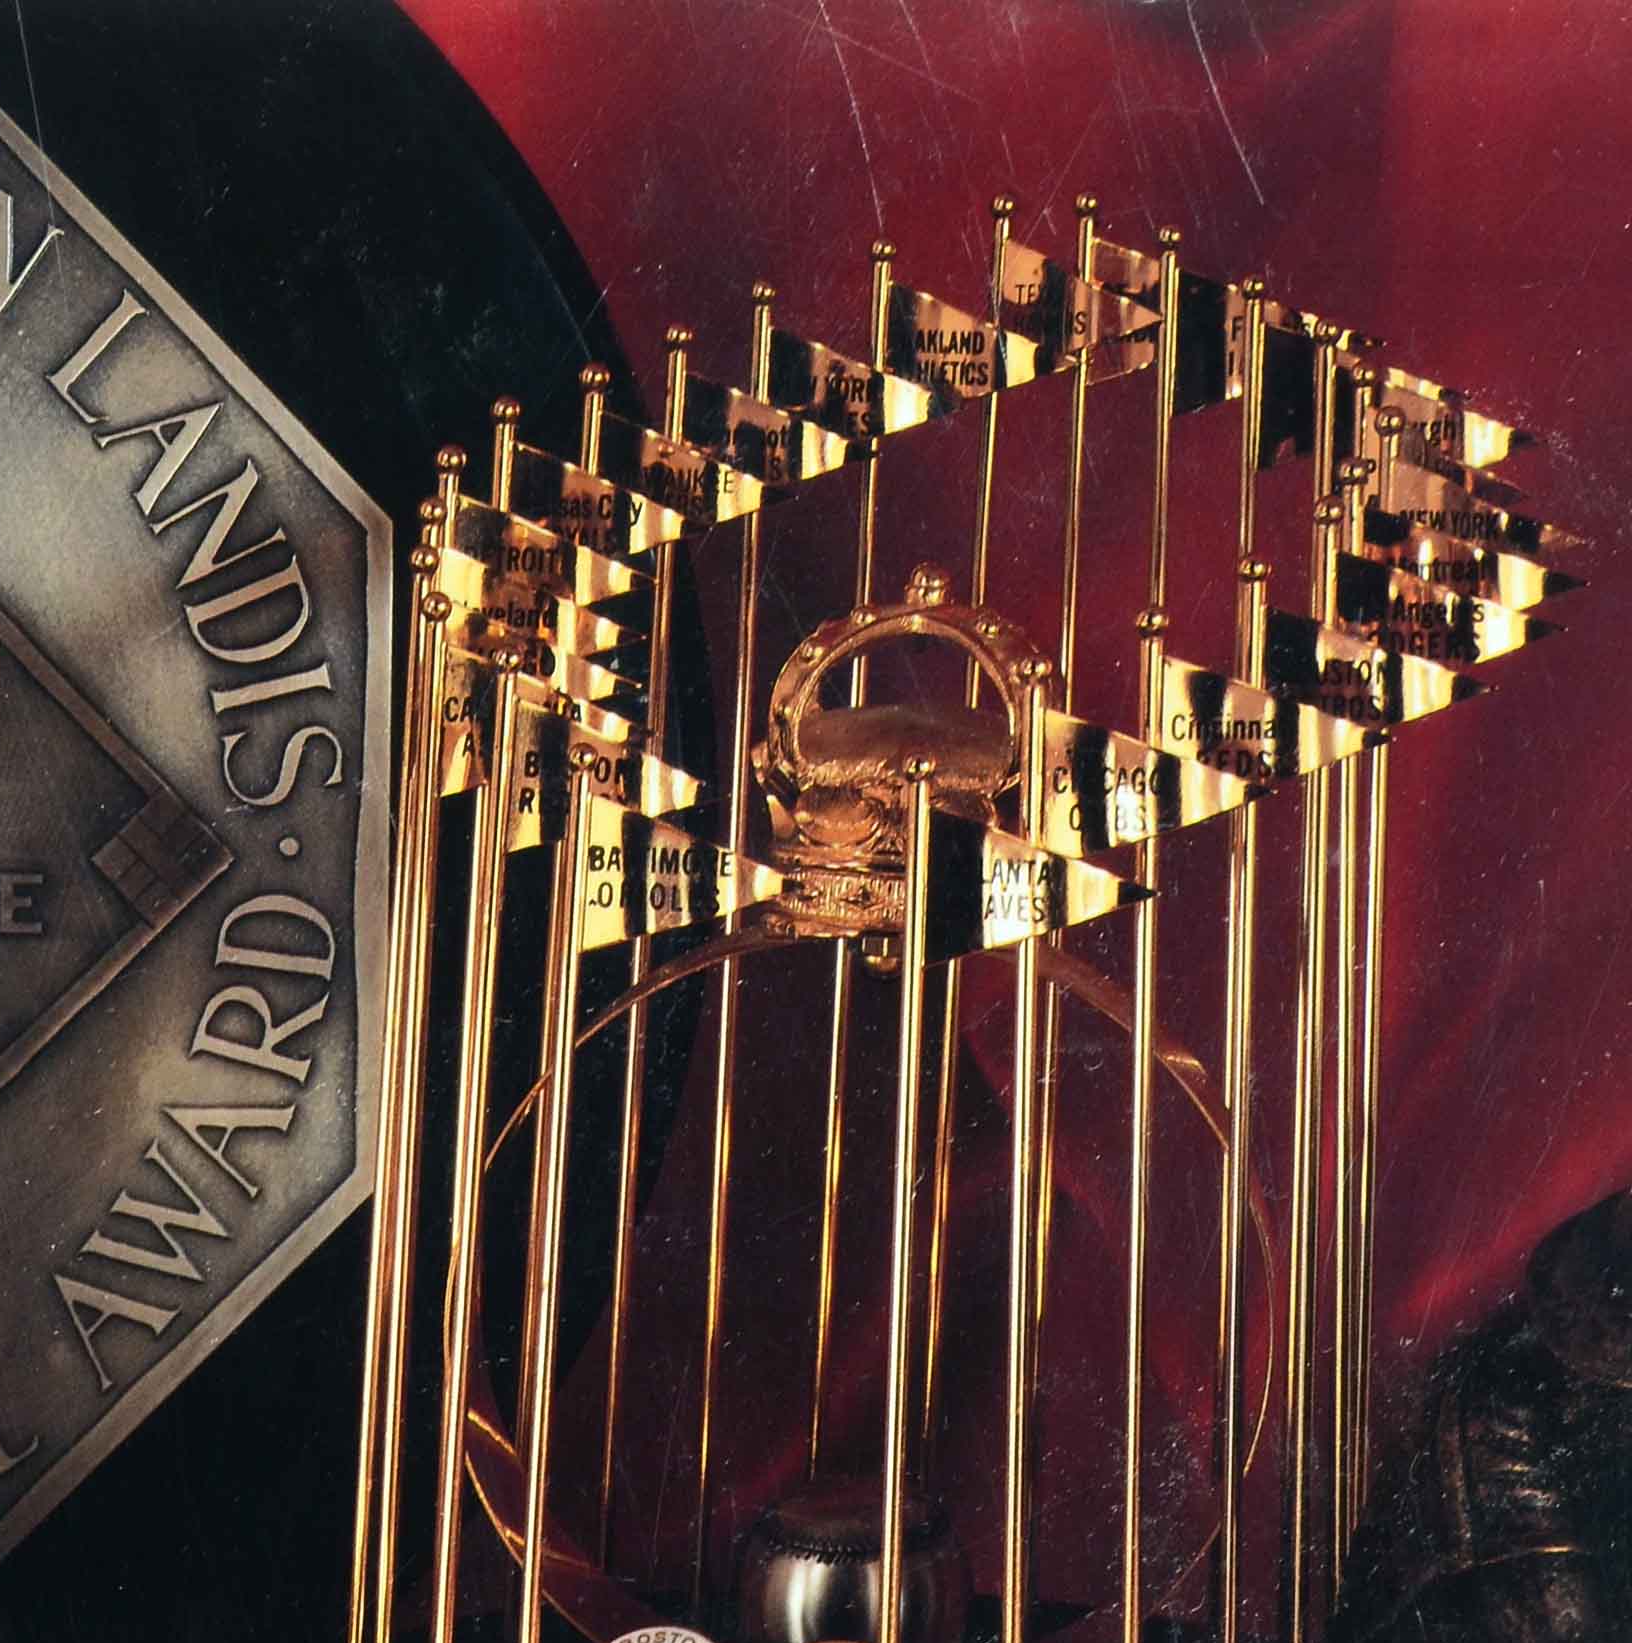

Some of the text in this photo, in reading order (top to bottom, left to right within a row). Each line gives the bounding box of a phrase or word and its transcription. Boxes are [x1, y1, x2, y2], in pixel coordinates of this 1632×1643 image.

[914, 329, 986, 357] AKLAND
[46, 288, 343, 808] LANDIS
[1053, 763, 1161, 795] CCAGO
[589, 845, 734, 877] BAIMOE
[984, 892, 1046, 922] AVES
[54, 893, 335, 1390] AWARD
